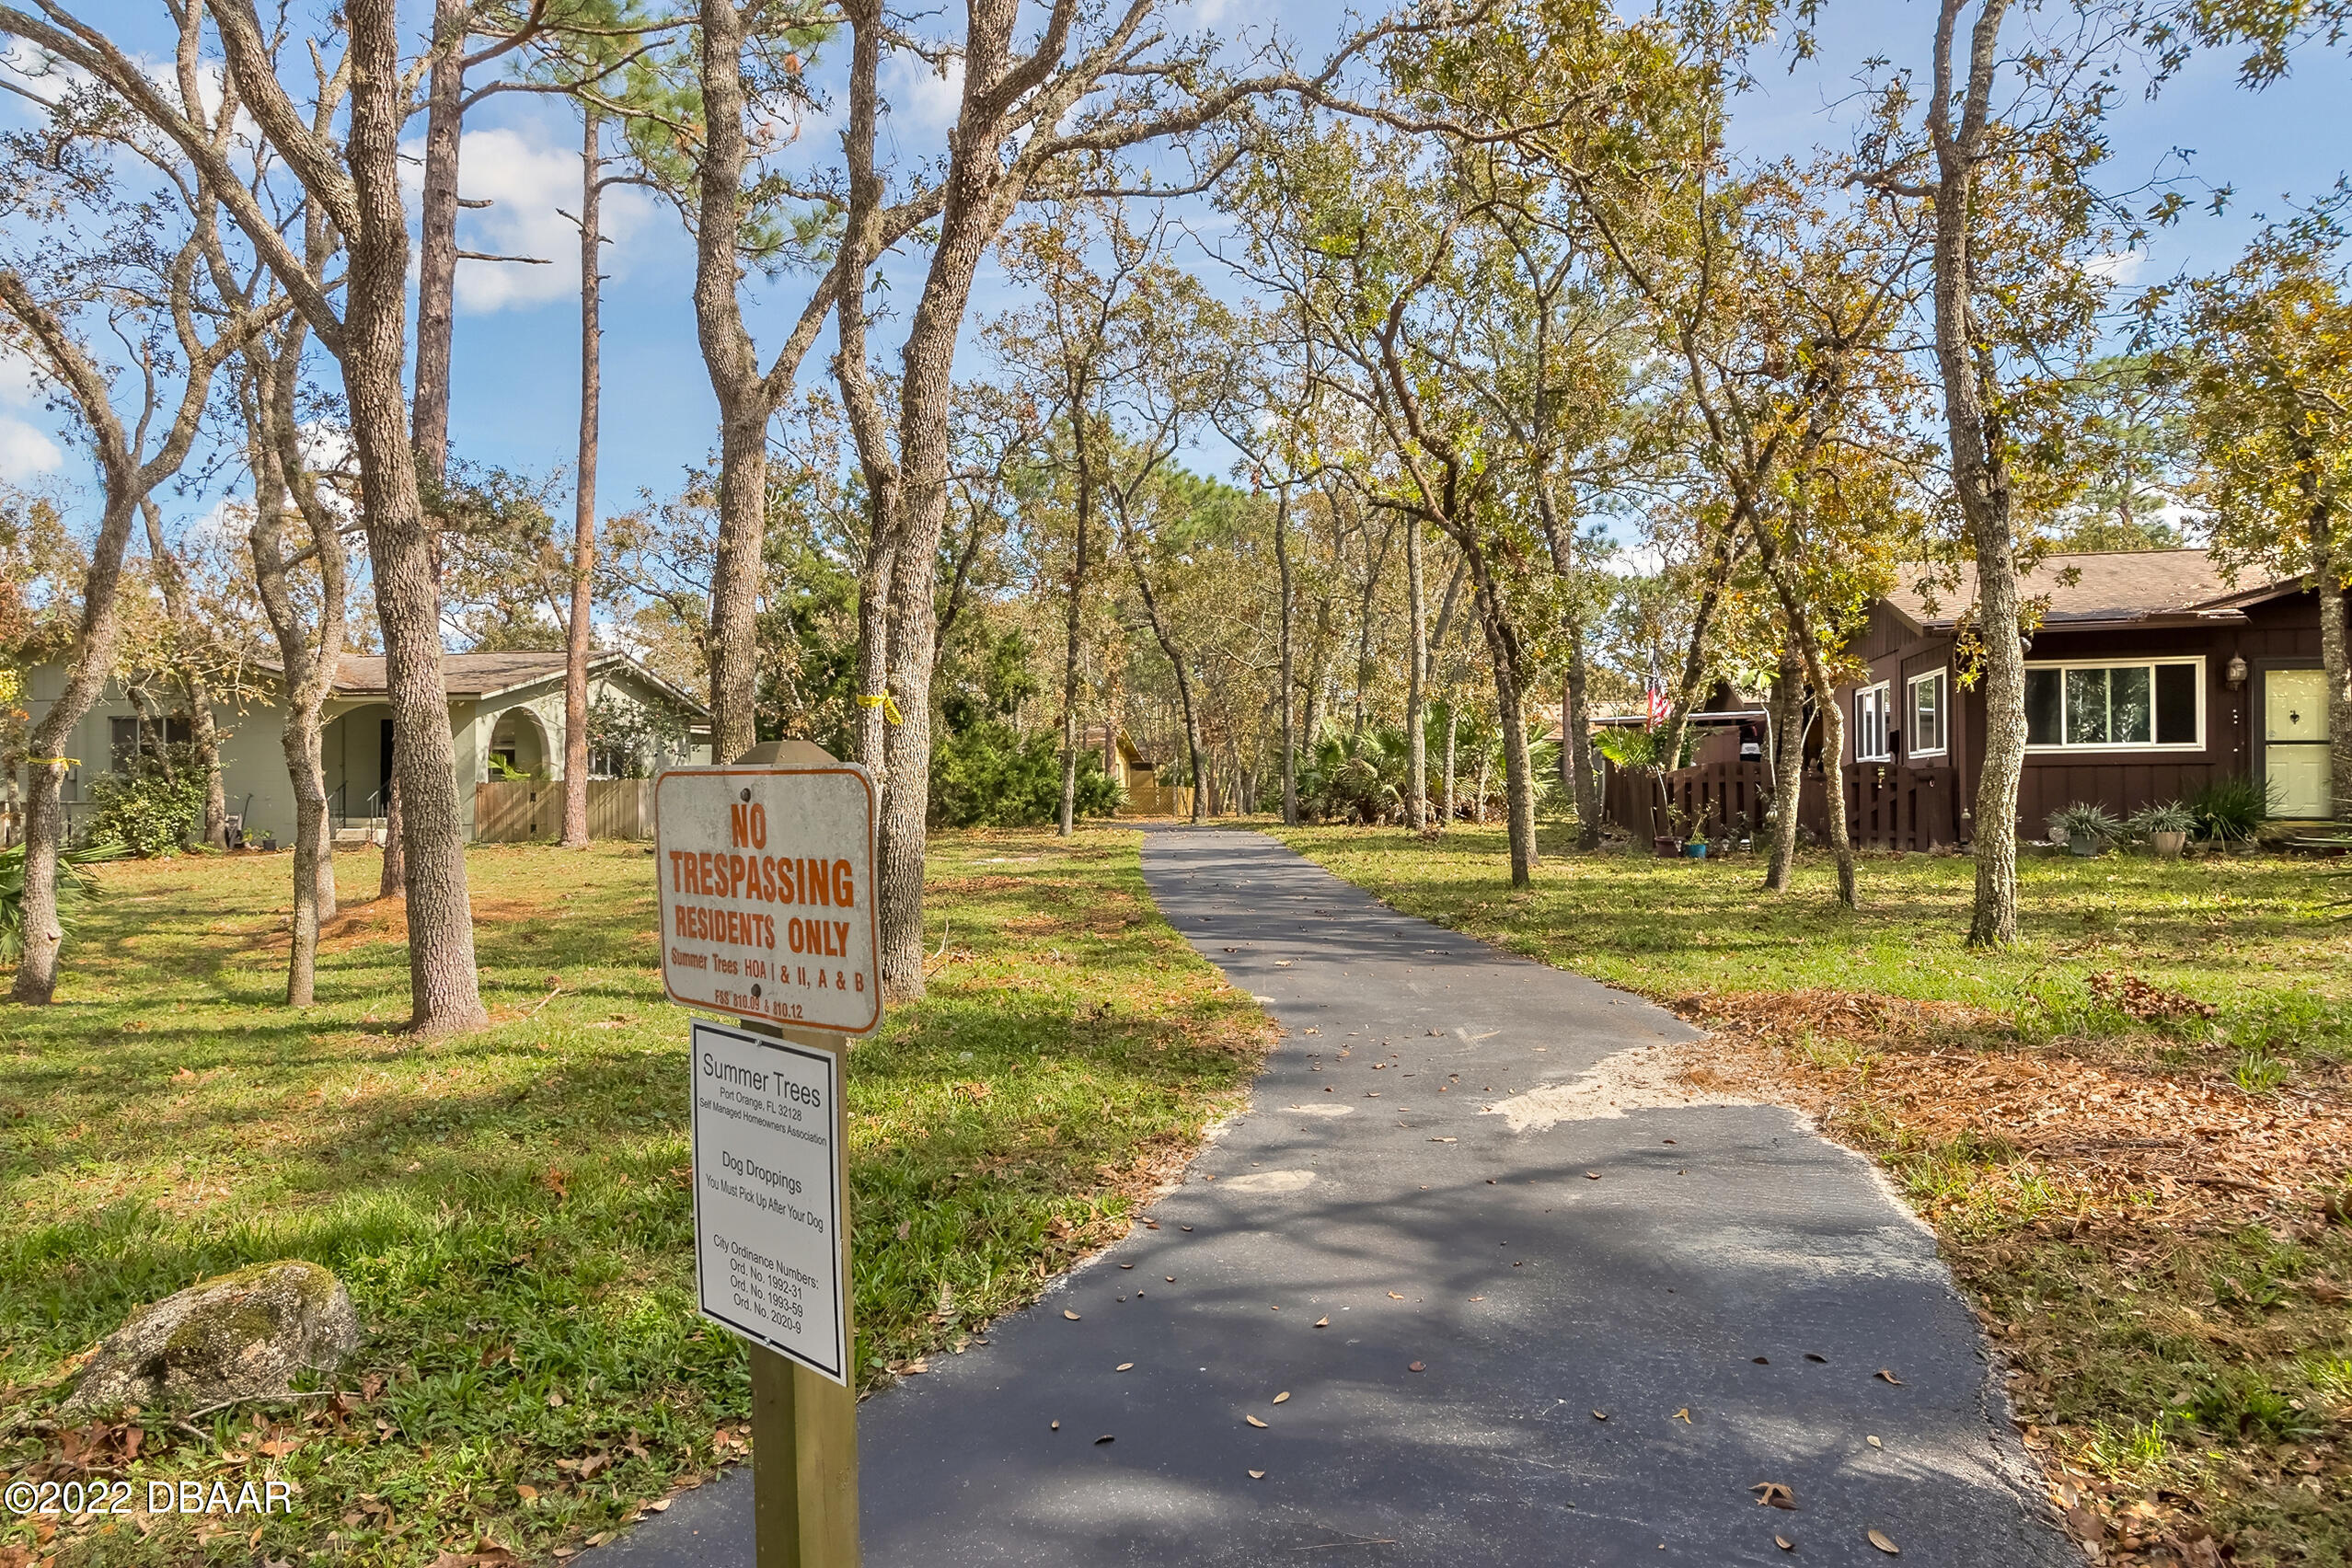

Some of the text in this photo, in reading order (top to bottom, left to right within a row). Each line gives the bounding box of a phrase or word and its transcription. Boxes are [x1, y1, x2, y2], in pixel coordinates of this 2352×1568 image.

[731, 802, 767, 850] NO
[669, 850, 855, 908] TRESPASSING
[674, 905, 850, 958] RESIDENTS ONLY
[671, 947, 864, 992] Summer Trees HOA I & II, A & B
[715, 989, 803, 1020] FSS 810.09 & 810.12
[703, 1053, 821, 1108] Summer Trees
[699, 1097, 827, 1147] Self Managed Homeowners Association
[720, 1087, 735, 1101] Port
[767, 1101, 776, 1114] FL
[778, 1103, 802, 1122] 32128
[722, 1150, 802, 1195] Dog Droppings
[706, 1173, 824, 1233] You Must Pick Up After Your Dog
[713, 1234, 819, 1290] City Ordinance Numbers:
[730, 1258, 802, 1300] Ord. No. 1992-31
[731, 1274, 803, 1318] Ord. No. 1993-59
[733, 1293, 801, 1334] Ord. No. 2020-9
